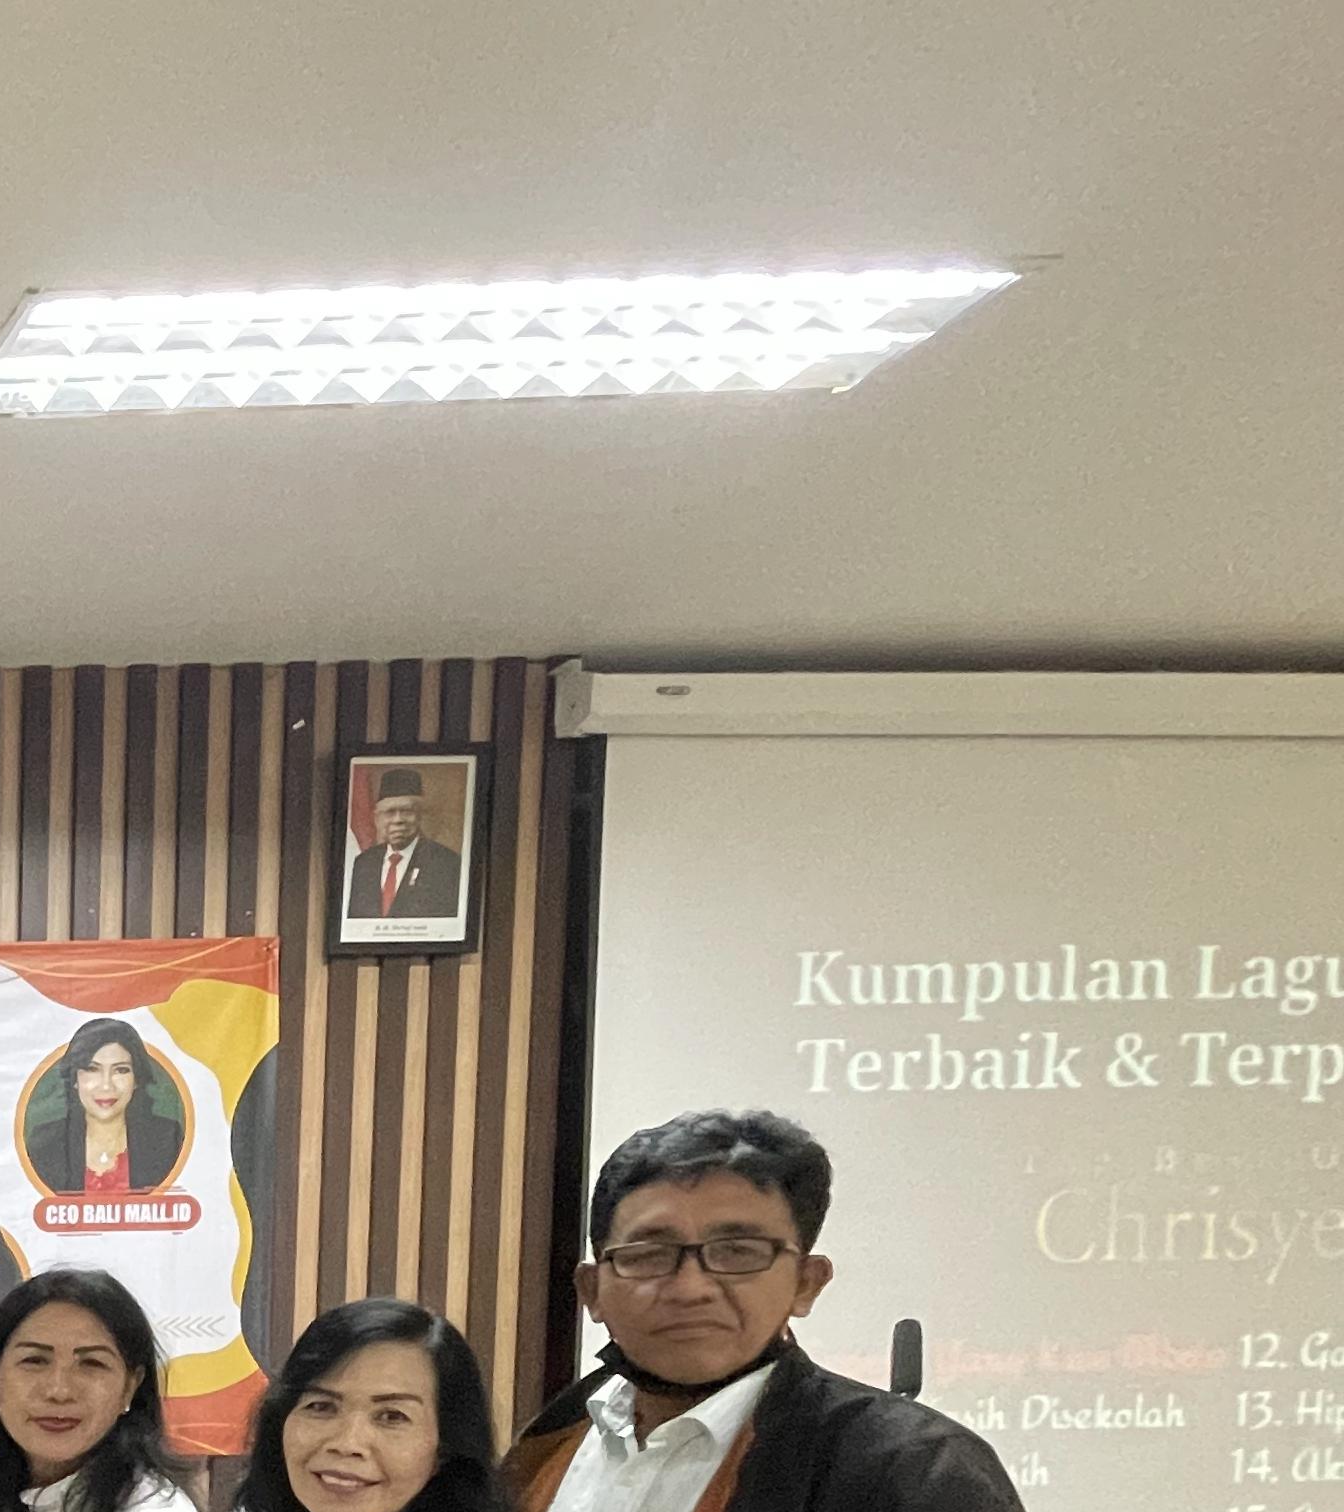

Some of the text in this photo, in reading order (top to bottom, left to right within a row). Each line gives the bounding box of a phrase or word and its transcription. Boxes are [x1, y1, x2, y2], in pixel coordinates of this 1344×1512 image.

[793, 944, 1168, 1021] Kumpulan
[797, 1032, 1082, 1093] Terbaik
[1106, 1033, 1159, 1089] &
[45, 1204, 80, 1225] CEO
[83, 1204, 121, 1224] BALI
[1240, 1332, 1288, 1369] 12.
[1021, 1394, 1185, 1430] Disekolah
[1237, 1390, 1283, 1431] 13.
[1232, 1448, 1278, 1484] 14.
